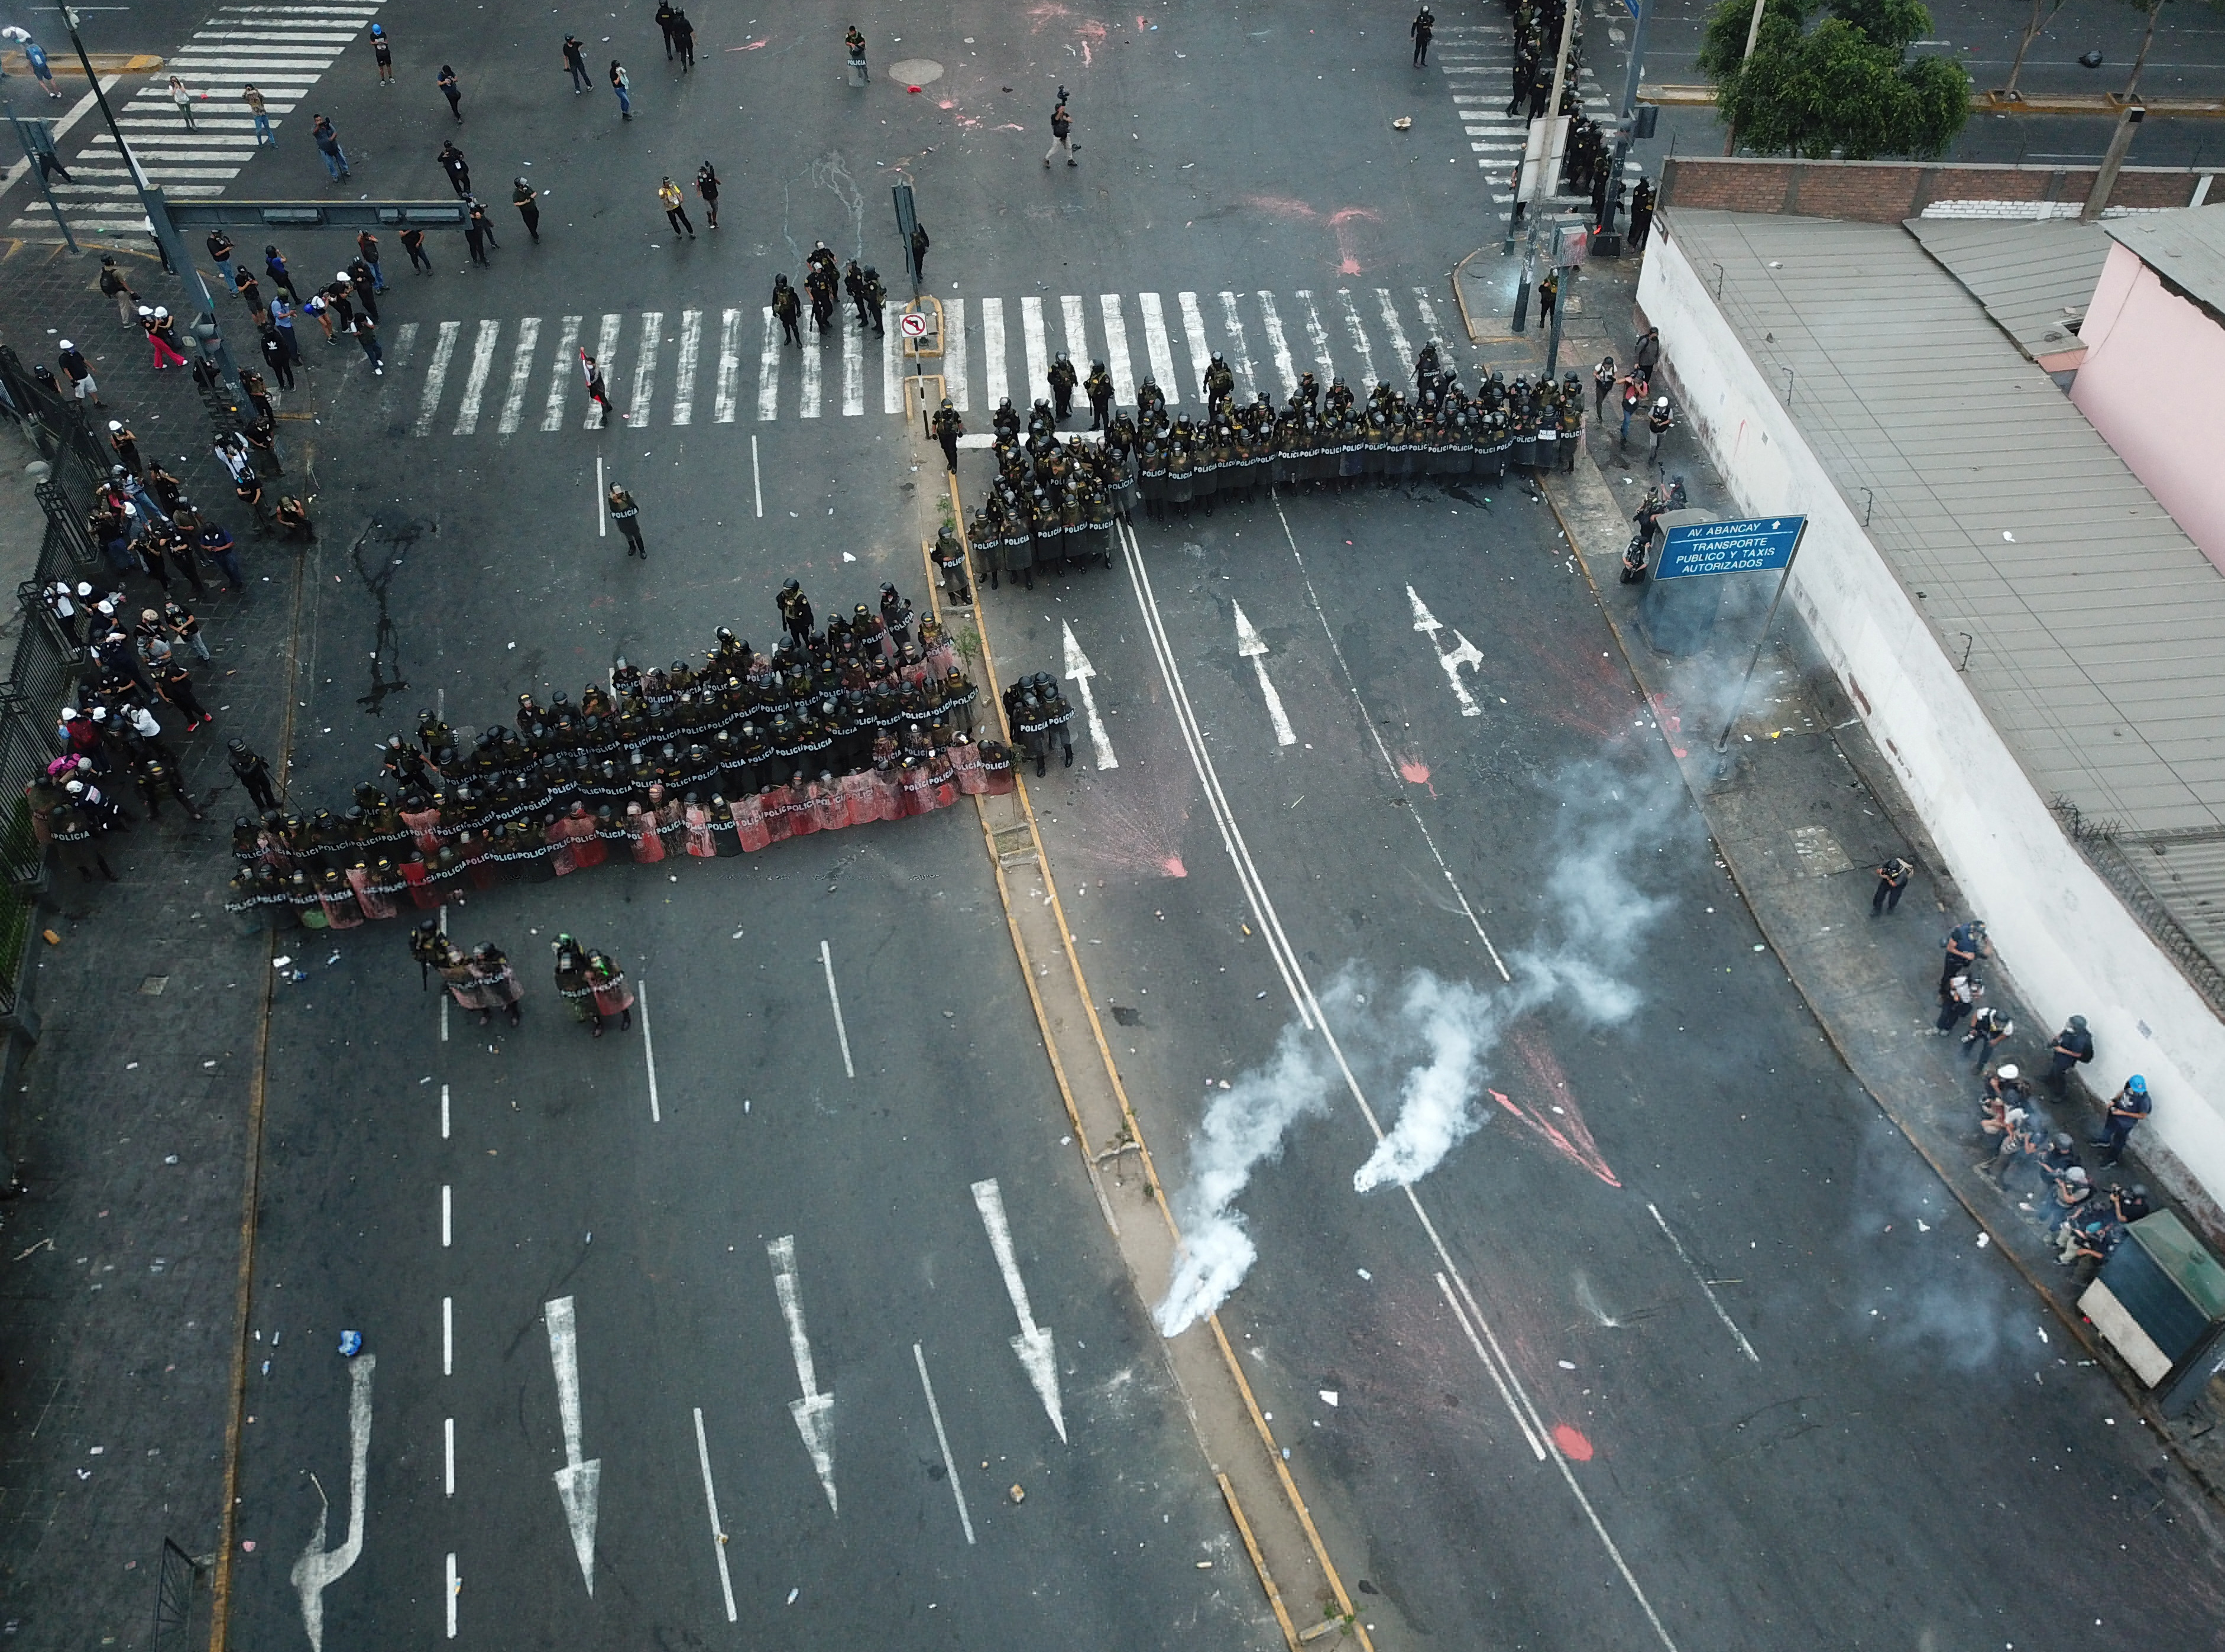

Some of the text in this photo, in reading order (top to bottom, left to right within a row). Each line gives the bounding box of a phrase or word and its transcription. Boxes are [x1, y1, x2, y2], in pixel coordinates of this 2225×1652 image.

[1561, 429, 1585, 439] POLICIA
[1301, 449, 1320, 457] POLICI
[1194, 462, 1217, 473] POLICIA
[1218, 459, 1236, 467] OLICI
[1142, 468, 1166, 477] POLICIA
[1108, 478, 1134, 490] POLICIA
[611, 508, 637, 518] POLICIA
[1089, 520, 1113, 530] POLICIA
[1688, 523, 1761, 537] AV. ABANCAY
[1038, 527, 1062, 538] POLICIA
[973, 539, 999, 550] POLICIA
[1004, 535, 1029, 545] POLICIA
[1692, 537, 1768, 552] TRANSPORTE
[1676, 548, 1775, 563] PUBLICO Y TAXIS
[943, 555, 965, 568] POLICIA
[1682, 559, 1763, 573] AUTORIZADOS
[889, 612, 914, 633] POLICIA
[862, 629, 887, 644] POLICIA
[617, 680, 641, 689] POLICI
[673, 685, 701, 695] POCIA
[819, 688, 844, 698] POLICI
[953, 688, 979, 707] POLICIA
[761, 703, 790, 712] POLICIA
[854, 715, 877, 725] OLICIA
[902, 711, 931, 720] POLICIA
[1049, 710, 1075, 724] POLICIA
[681, 725, 706, 734] POLICI
[1021, 721, 1048, 732] POLICIA
[591, 740, 621, 754] POLICIA
[804, 738, 833, 751] POLICIA
[564, 749, 590, 757] POLICI
[748, 747, 775, 763] POLICIA
[905, 747, 927, 757] POLICI
[720, 759, 746, 769] OLICIA
[982, 760, 1010, 770] POLICIA
[692, 765, 719, 781] POLICIA
[929, 768, 953, 784] POLICIA
[548, 780, 578, 795] POLICIA
[666, 776, 691, 788] POLICI
[904, 779, 928, 791] POLICI
[602, 785, 633, 795] POLICIA
[524, 795, 553, 811] POLICIA
[788, 801, 814, 811] POLICI
[765, 806, 786, 817] POLIC
[467, 811, 495, 828] POLICIA
[656, 820, 681, 834] POLICI
[707, 821, 735, 830] POLICI
[52, 831, 90, 841] POLICIA
[571, 834, 597, 843] POLICI
[596, 829, 626, 838] POLICIA
[548, 837, 571, 851] POLIC
[237, 847, 270, 859] POLICIA
[296, 848, 318, 857] OLICI
[490, 853, 517, 861] POLICI
[518, 847, 546, 859] POLICI
[467, 853, 490, 865] POLIC
[437, 860, 466, 878] POLICIA
